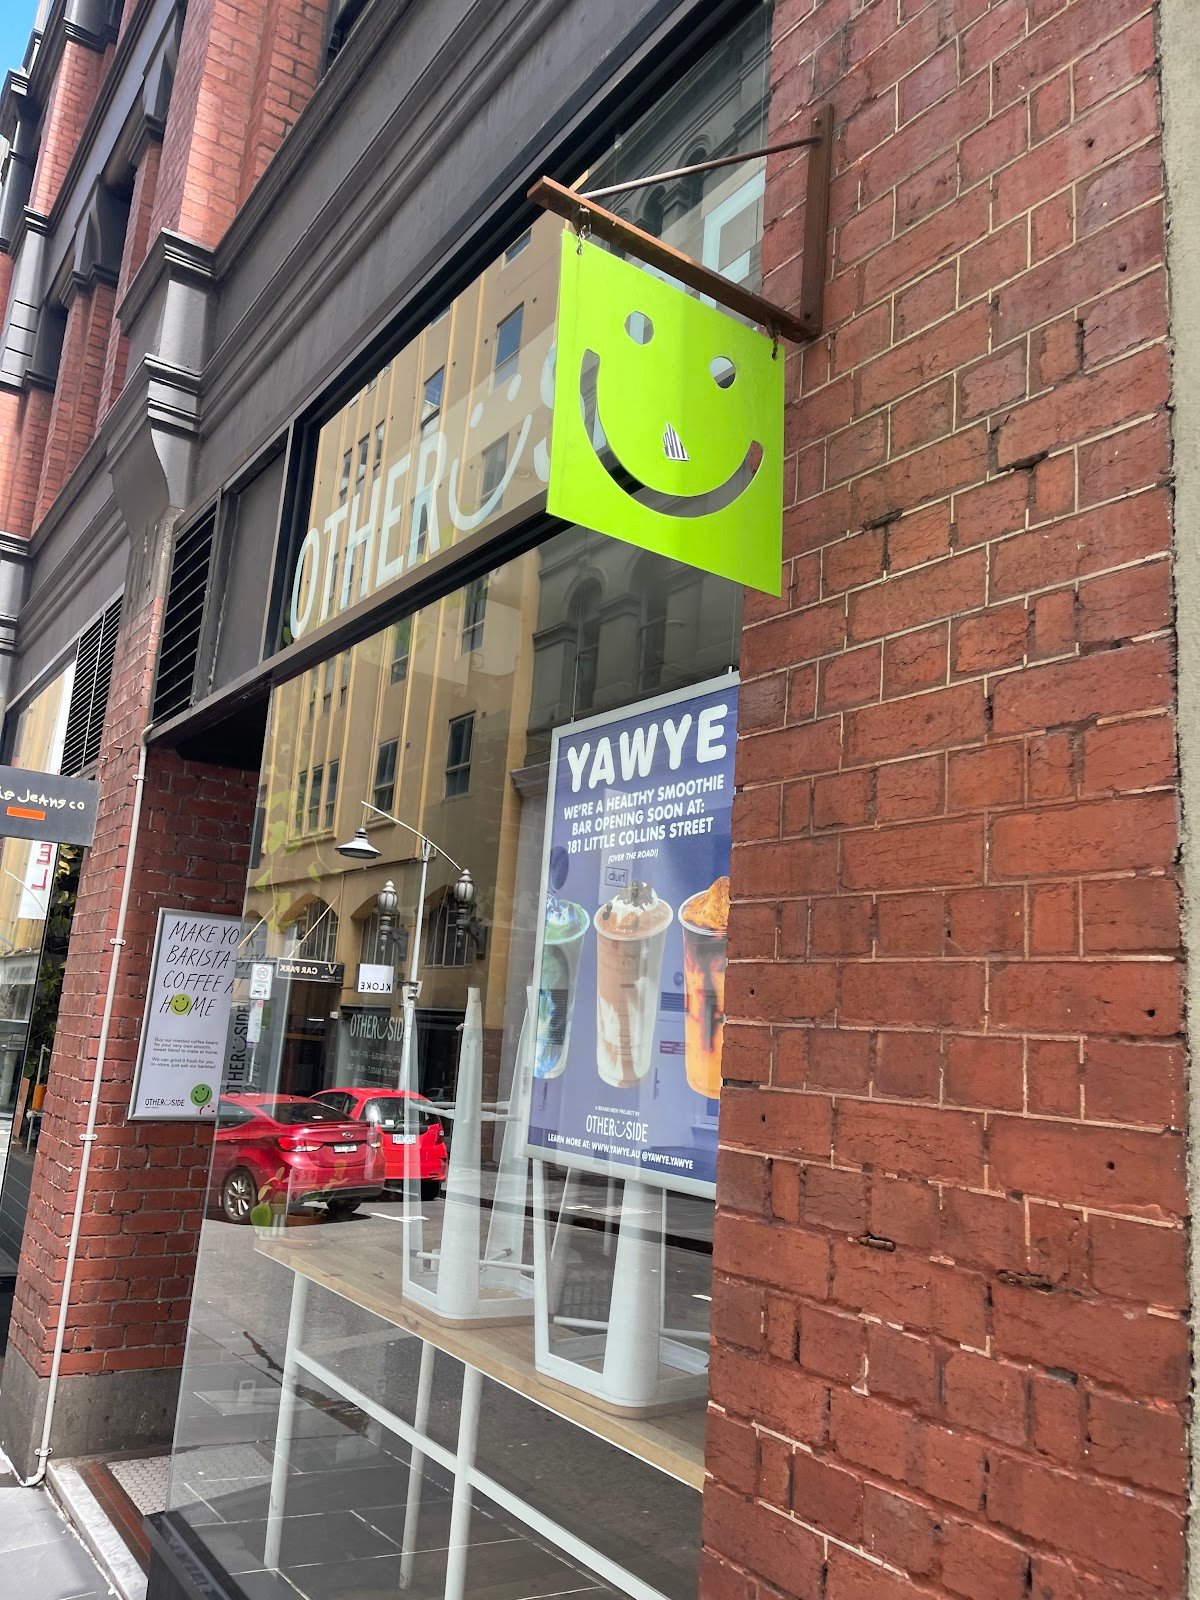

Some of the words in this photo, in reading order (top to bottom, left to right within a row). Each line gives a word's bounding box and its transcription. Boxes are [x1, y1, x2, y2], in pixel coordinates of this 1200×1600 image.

[290, 431, 447, 639] OTHER
[567, 704, 728, 793] YAWYE
[563, 801, 593, 821] WE'RE
[596, 799, 603, 810] A
[606, 789, 654, 812] HEALTHY
[657, 773, 725, 802] SMOOTHIE
[572, 822, 592, 836] BAR
[594, 811, 644, 832] OPENING
[647, 803, 683, 823] SOON
[687, 798, 705, 816] AT:
[567, 839, 582, 854] 181
[584, 833, 615, 851] LITTLE
[618, 825, 666, 846] COLLINS
[669, 816, 714, 839] STREET
[625, 851, 637, 861] THE
[168, 920, 219, 943] MAKE
[163, 970, 225, 993] COFFEE
[350, 1013, 377, 1039] OTHER
[144, 1098, 164, 1106] OTHER
[171, 1099, 185, 1107] SIDE
[586, 1114, 615, 1137] OTHER
[625, 1120, 649, 1143] SIDE
[547, 1134, 565, 1144] LEARN
[565, 1137, 581, 1148] MORE
[581, 1140, 591, 1149] AT:
[591, 1142, 641, 1160] WWW.YAWYE.AU
[641, 1151, 694, 1170] @YAWYE.YAWYE
